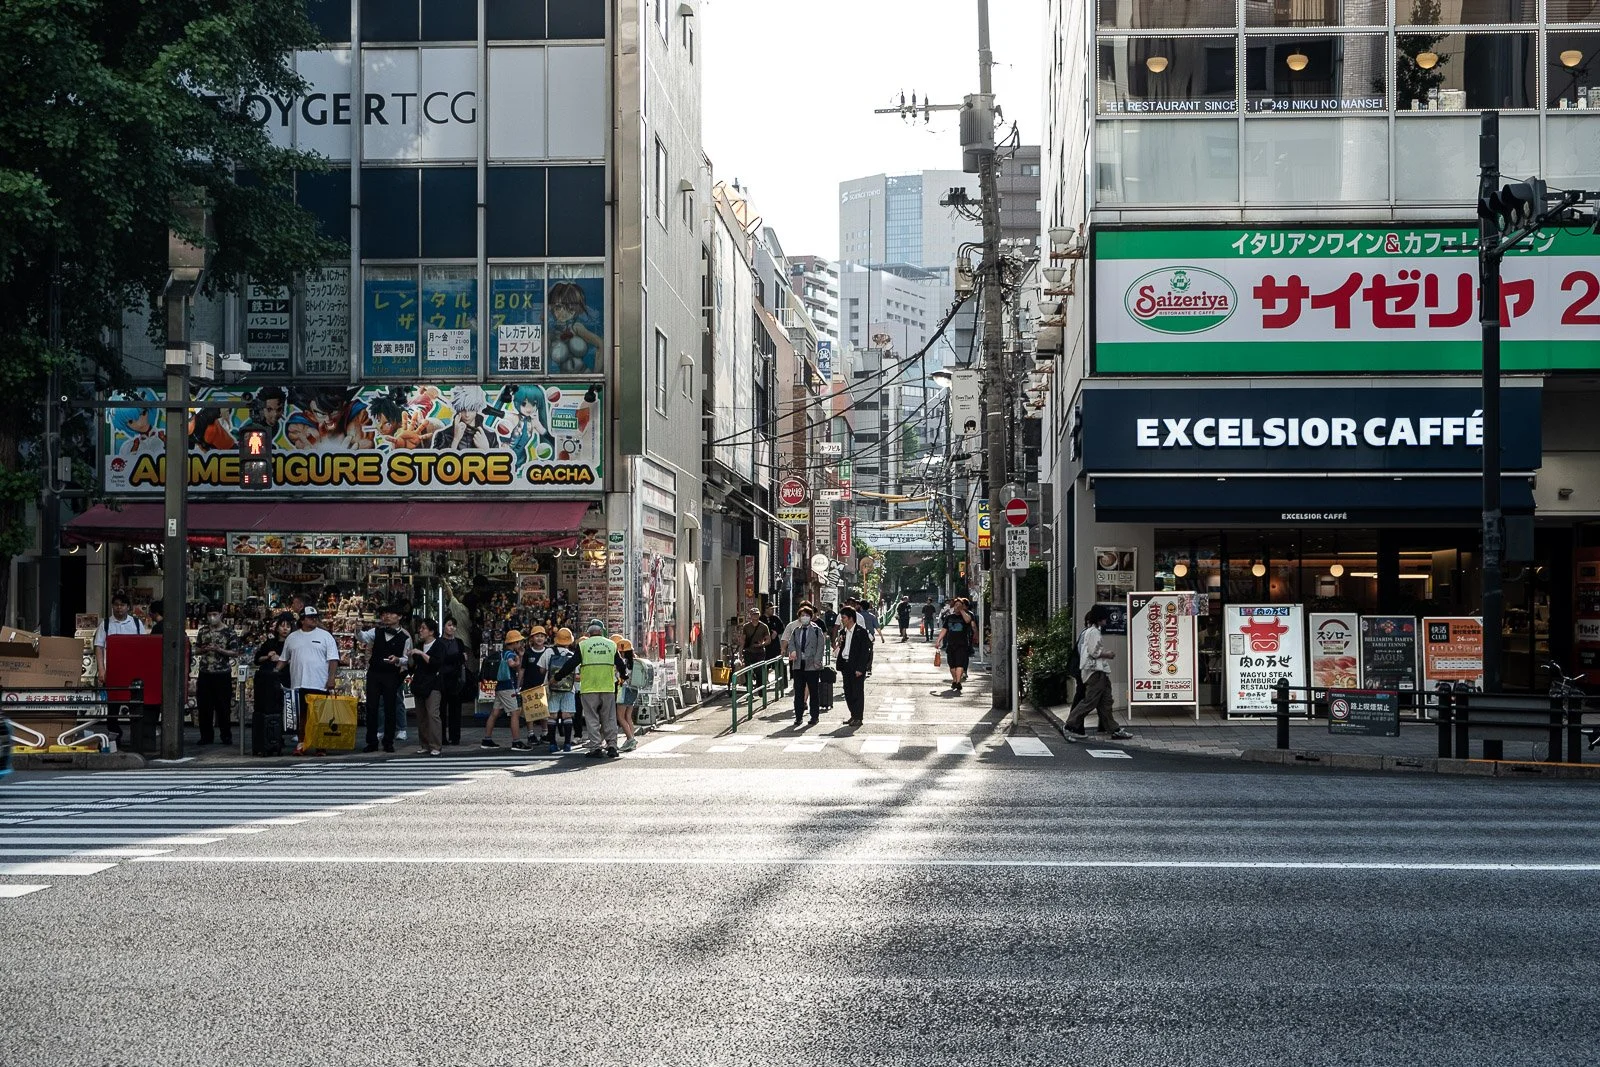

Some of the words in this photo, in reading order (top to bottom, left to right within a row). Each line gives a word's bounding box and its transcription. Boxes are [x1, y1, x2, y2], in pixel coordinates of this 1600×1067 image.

[391, 91, 477, 125] TCG
[1127, 101, 1201, 111] RESTAURANT
[1204, 101, 1236, 111] SINCE
[1292, 100, 1318, 110] NIKU
[1321, 99, 1338, 109] NO
[1341, 98, 1383, 109] MANSEI
[375, 291, 471, 310] レンタル
[495, 293, 534, 310] BOX
[1136, 285, 1229, 314] Saizeriya
[1253, 269, 1535, 330] サイゼリヤ
[251, 301, 286, 312] 鉄コレ
[250, 317, 288, 325] バスコレ
[499, 326, 541, 339] トレカテレカ
[373, 343, 414, 354] 営業時間
[499, 341, 541, 353] コスプレ
[499, 356, 541, 370] 鉄道模型
[1137, 418, 1357, 447] EXCELSIOR
[1363, 409, 1484, 446] CAFFÉ
[132, 456, 240, 483] AME
[271, 456, 380, 483] IGURE
[390, 456, 510, 483] STORE
[529, 468, 592, 482] GACHA
[1323, 512, 1347, 520] CAFFÉ
[1132, 600, 1146, 608] 6F
[1148, 603, 1162, 676] まねきねこ
[1165, 614, 1179, 664] カラオケ
[1316, 631, 1352, 640] スシロー
[1239, 655, 1293, 668] 肉の万世
[1136, 680, 1152, 690] 24
[1350, 702, 1390, 711] 路上喫煙禁止
[286, 698, 294, 729] TRADER
